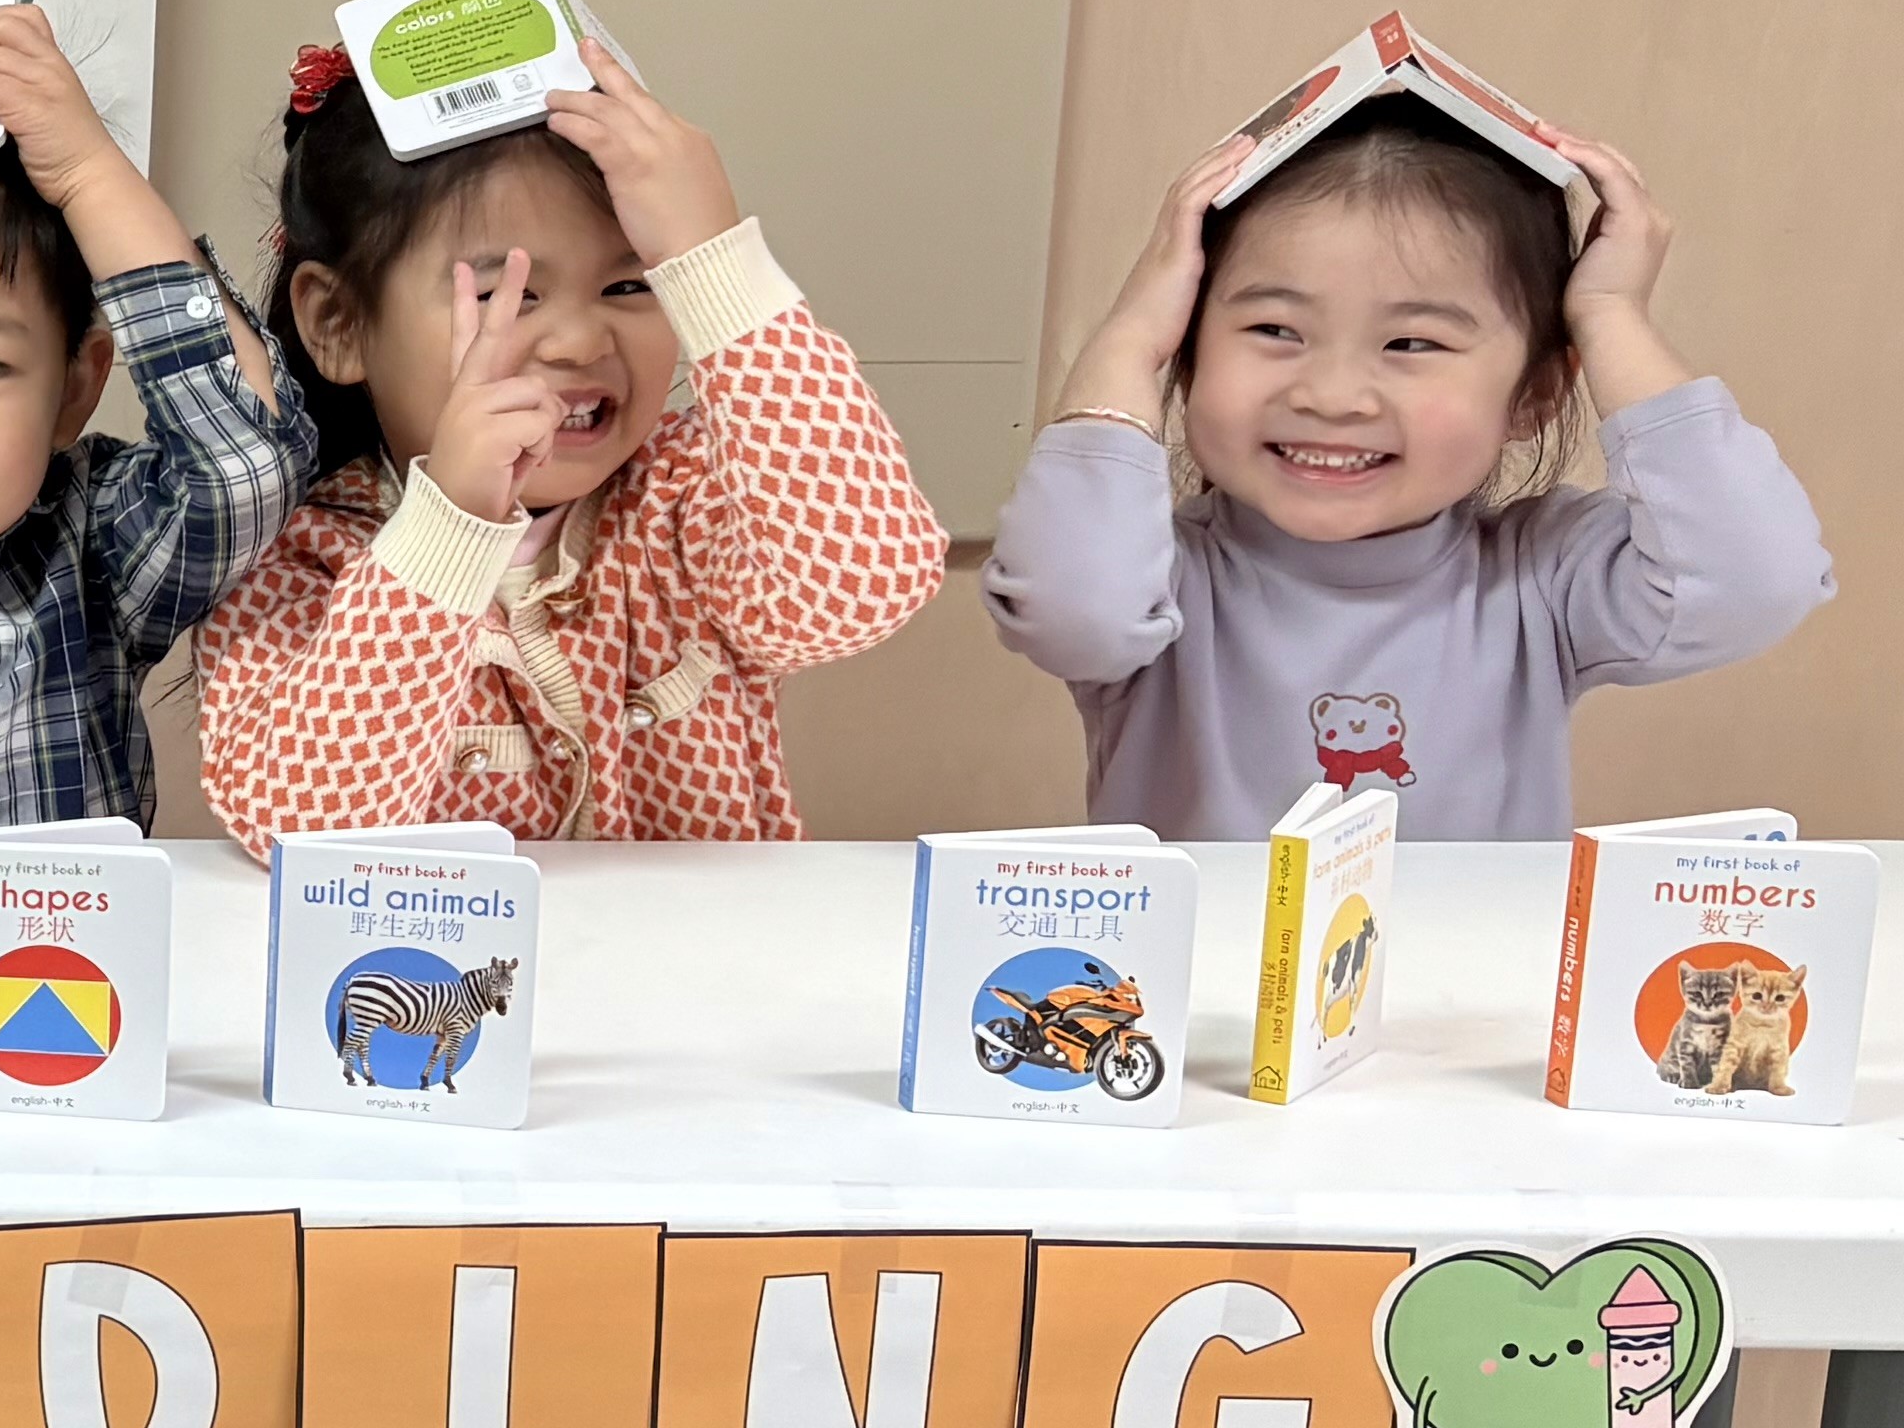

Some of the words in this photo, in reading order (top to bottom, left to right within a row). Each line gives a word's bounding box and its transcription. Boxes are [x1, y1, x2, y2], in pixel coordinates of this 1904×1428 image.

[395, 10, 455, 35] colors
[16, 862, 48, 876] first
[52, 863, 83, 877] book
[87, 865, 103, 877] of
[354, 862, 373, 877] my
[378, 863, 411, 877] first
[415, 865, 447, 880] book
[452, 868, 467, 880] of
[998, 862, 1020, 877] my
[1027, 861, 1066, 876] first
[1071, 862, 1109, 878] book
[1115, 864, 1133, 878] of
[1676, 857, 1697, 870] my
[1703, 856, 1738, 870] first
[1744, 857, 1779, 871] book
[1783, 860, 1801, 872] of
[304, 878, 370, 908] wild
[385, 888, 516, 918] animals
[975, 878, 1151, 914] transport
[1654, 876, 1816, 909] numbers
[17, 916, 75, 943] 形状
[350, 911, 465, 943] 野生动物
[997, 910, 1124, 942] 交通工具
[1697, 910, 1764, 938] 数字
[1560, 916, 1579, 1002] numbers
[1277, 957, 1289, 1006] animals
